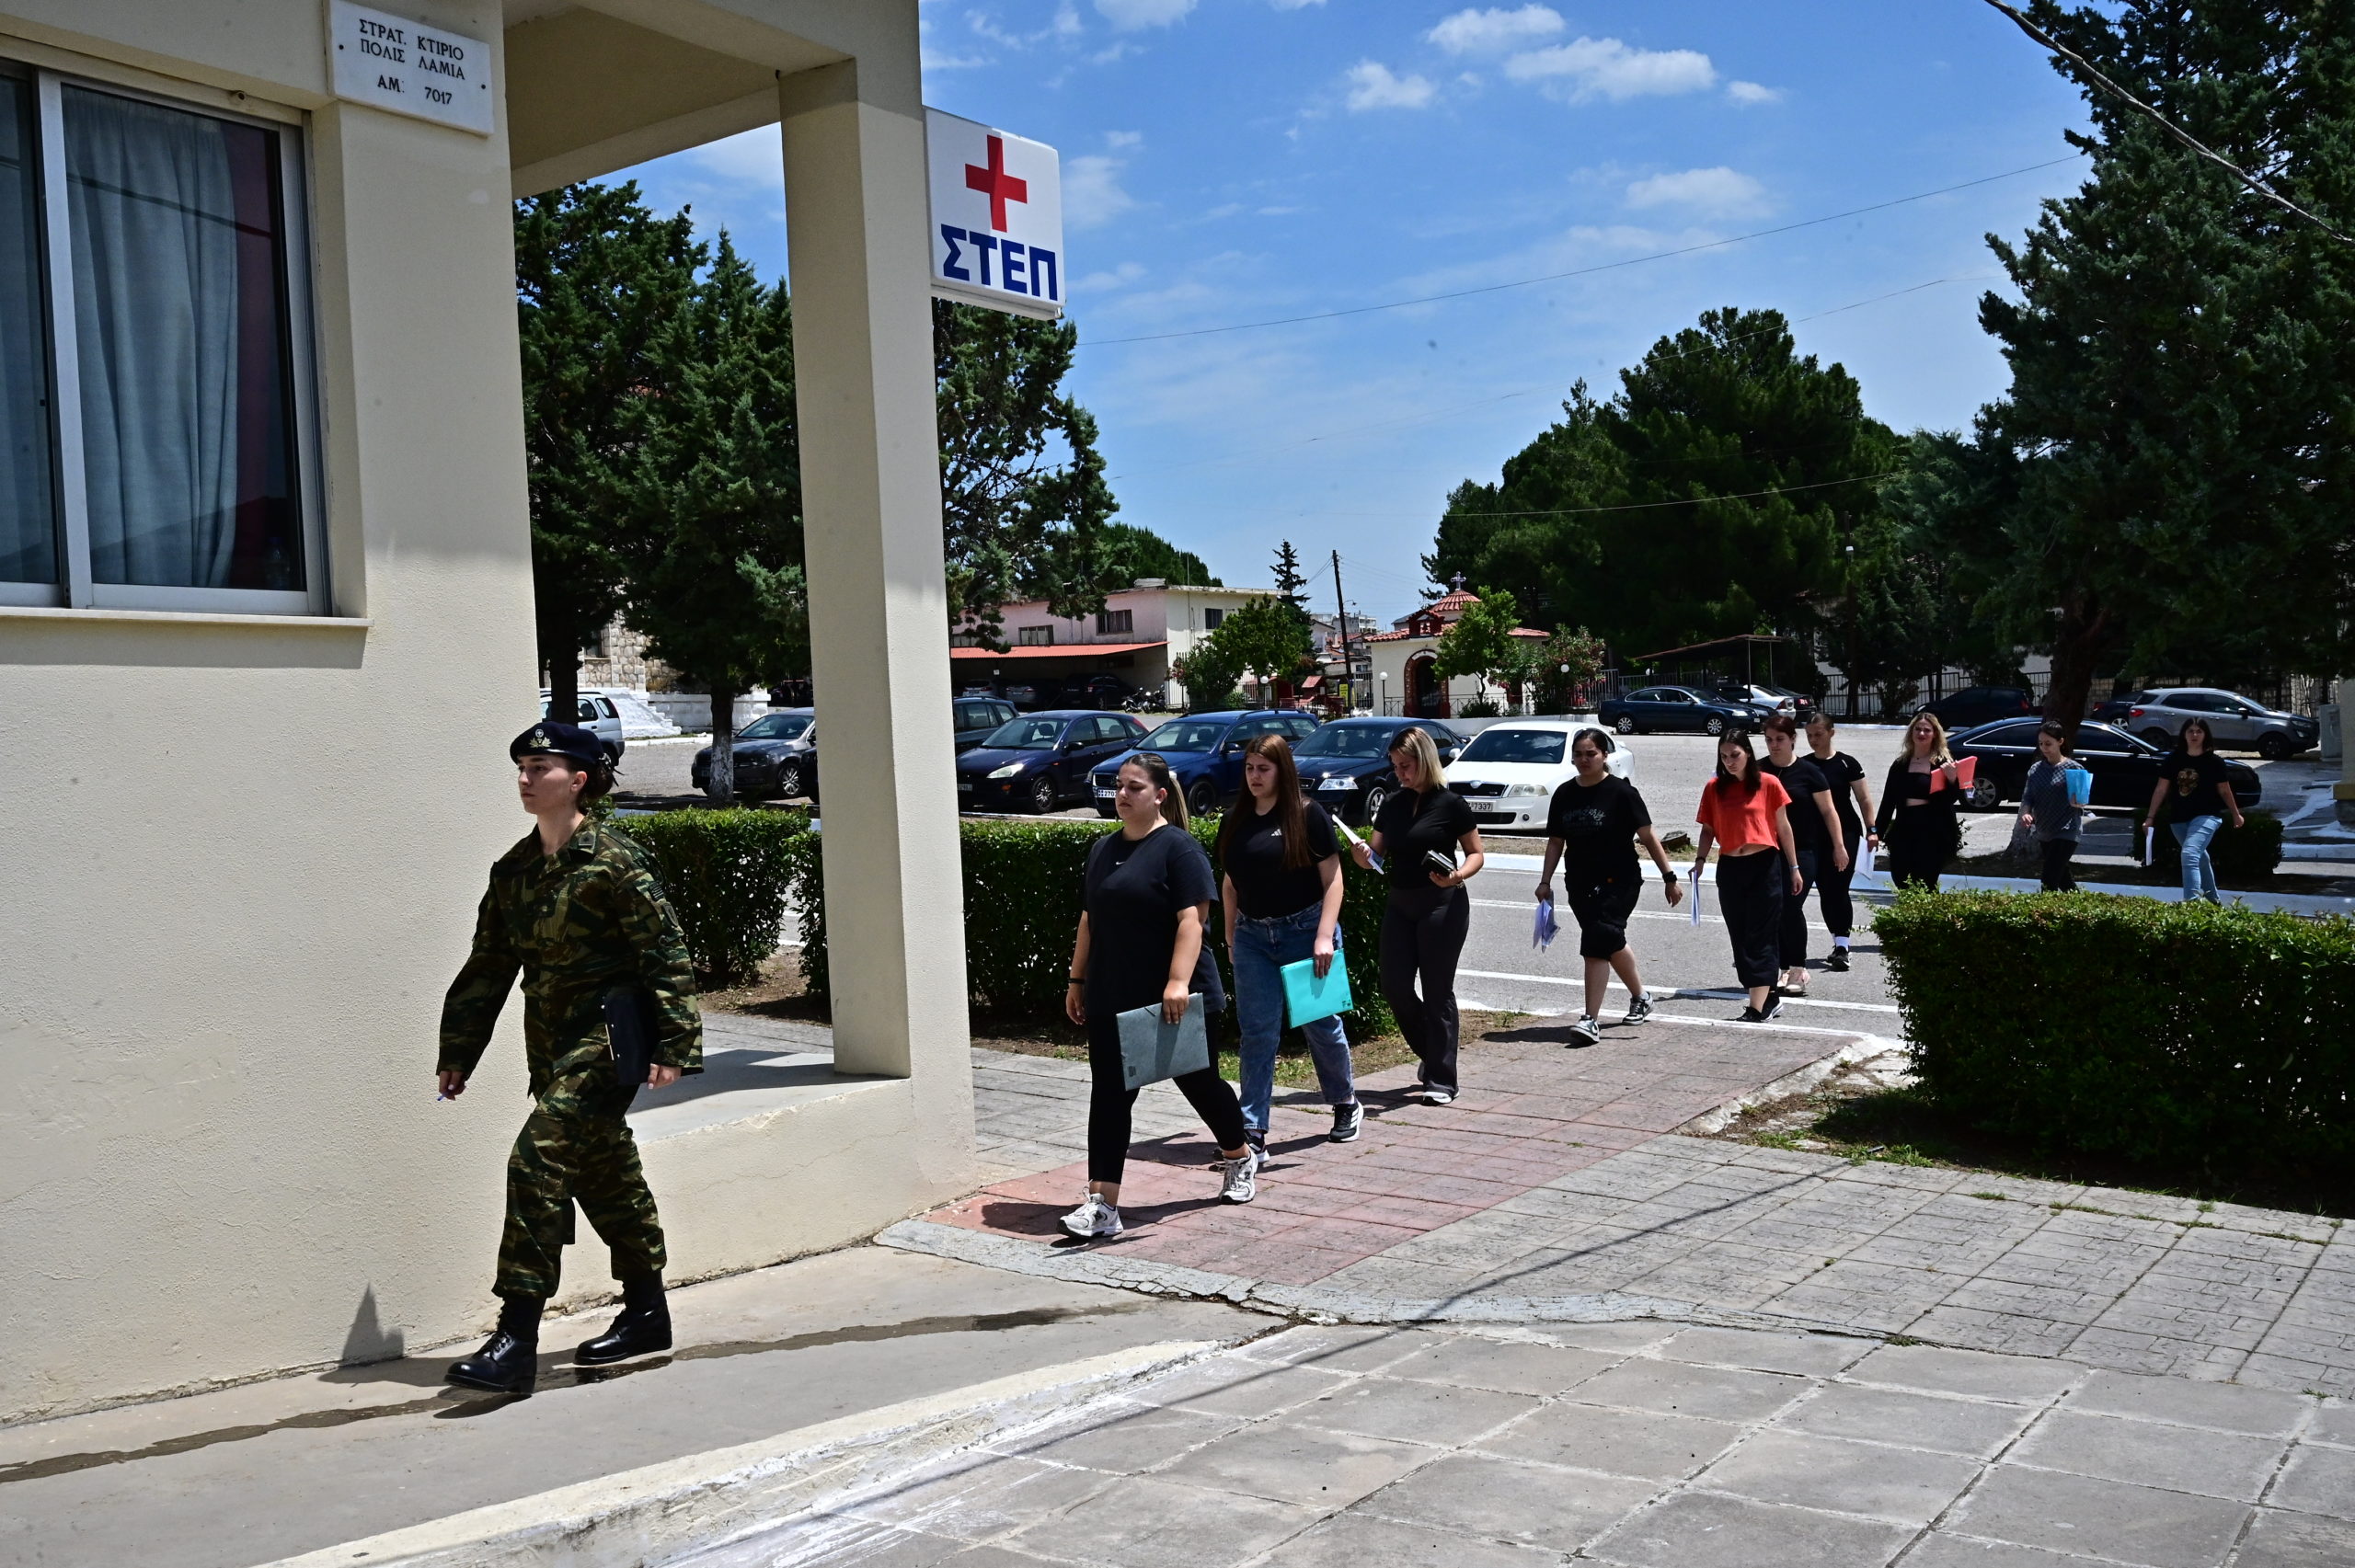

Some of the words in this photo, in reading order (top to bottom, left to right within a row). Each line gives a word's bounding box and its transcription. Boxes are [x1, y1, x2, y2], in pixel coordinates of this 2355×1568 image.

[359, 18, 407, 45] ΣΤΡΑΤ.
[418, 35, 464, 61] ΚΤΙΡΙΟ
[361, 39, 405, 63] ΠΟΛΙΣ
[418, 56, 465, 80] ΛΑΜΙΑ
[424, 86, 452, 105] 7017
[941, 223, 1058, 301] ΣΤΕΠ
